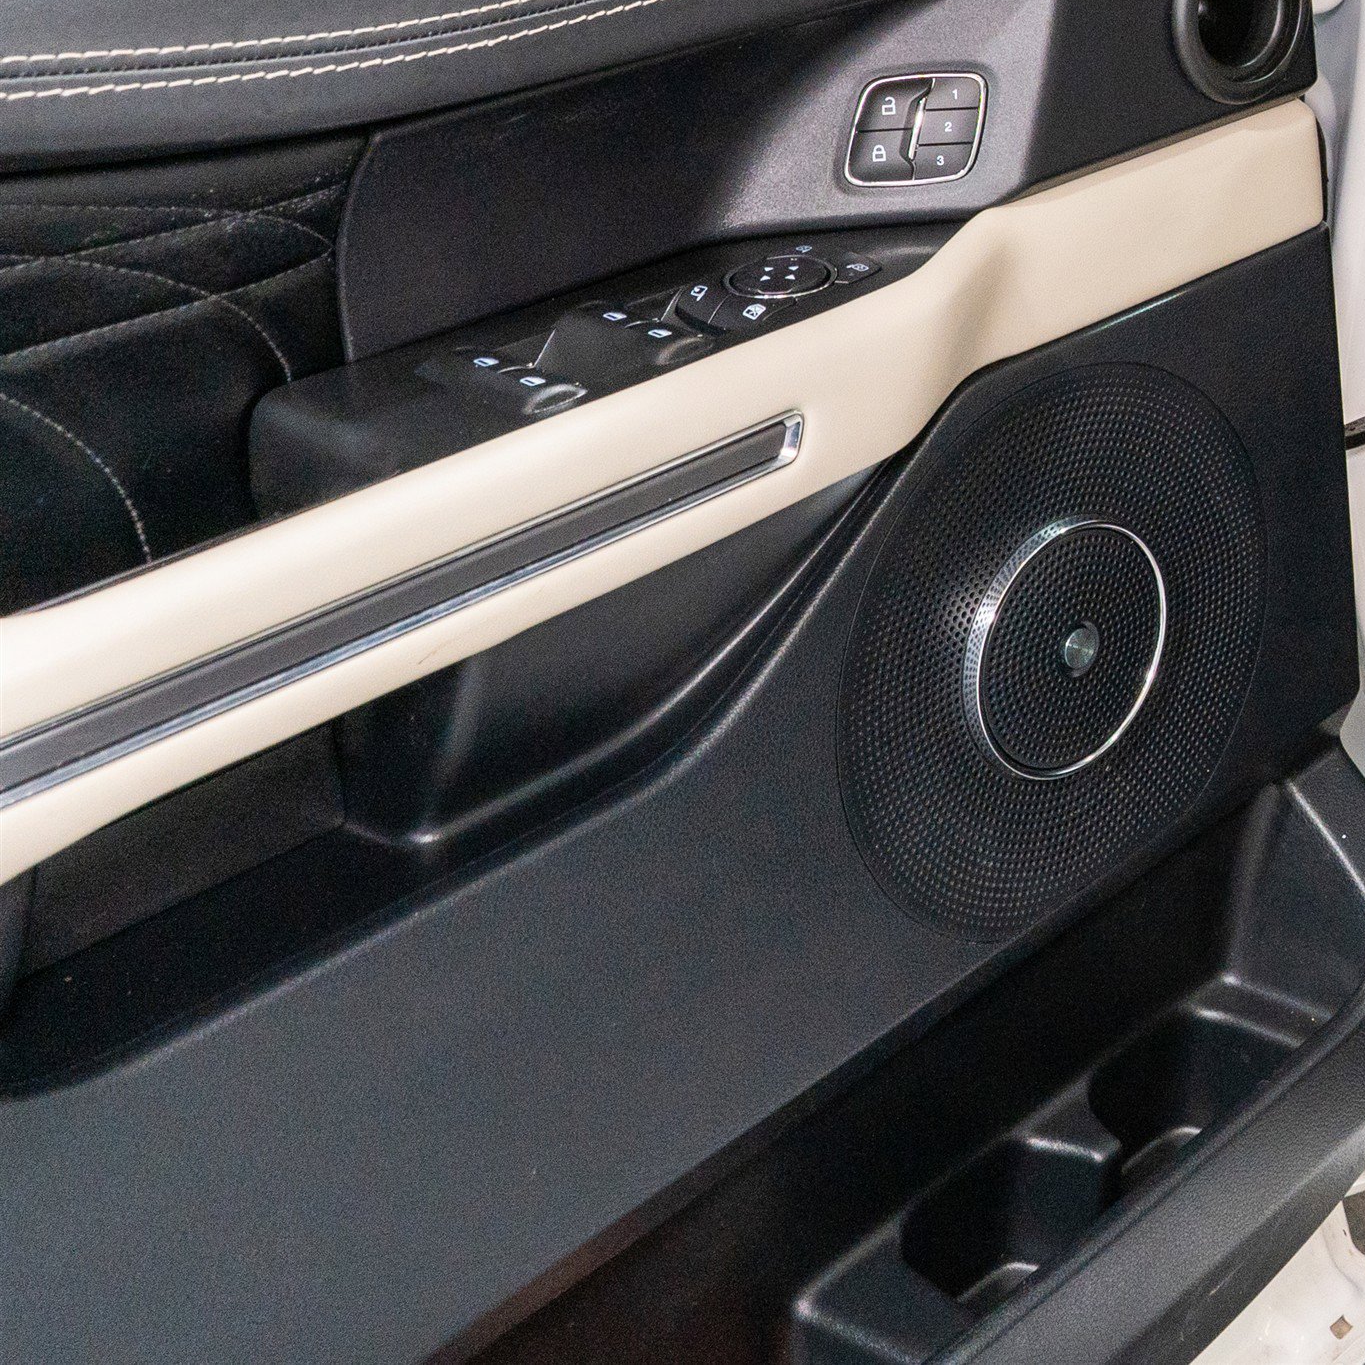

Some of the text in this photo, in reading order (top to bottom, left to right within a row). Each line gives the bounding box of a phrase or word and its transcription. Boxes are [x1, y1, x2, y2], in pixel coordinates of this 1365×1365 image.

[952, 89, 958, 100] 1
[944, 121, 952, 132] 2
[936, 155, 944, 166] 3
